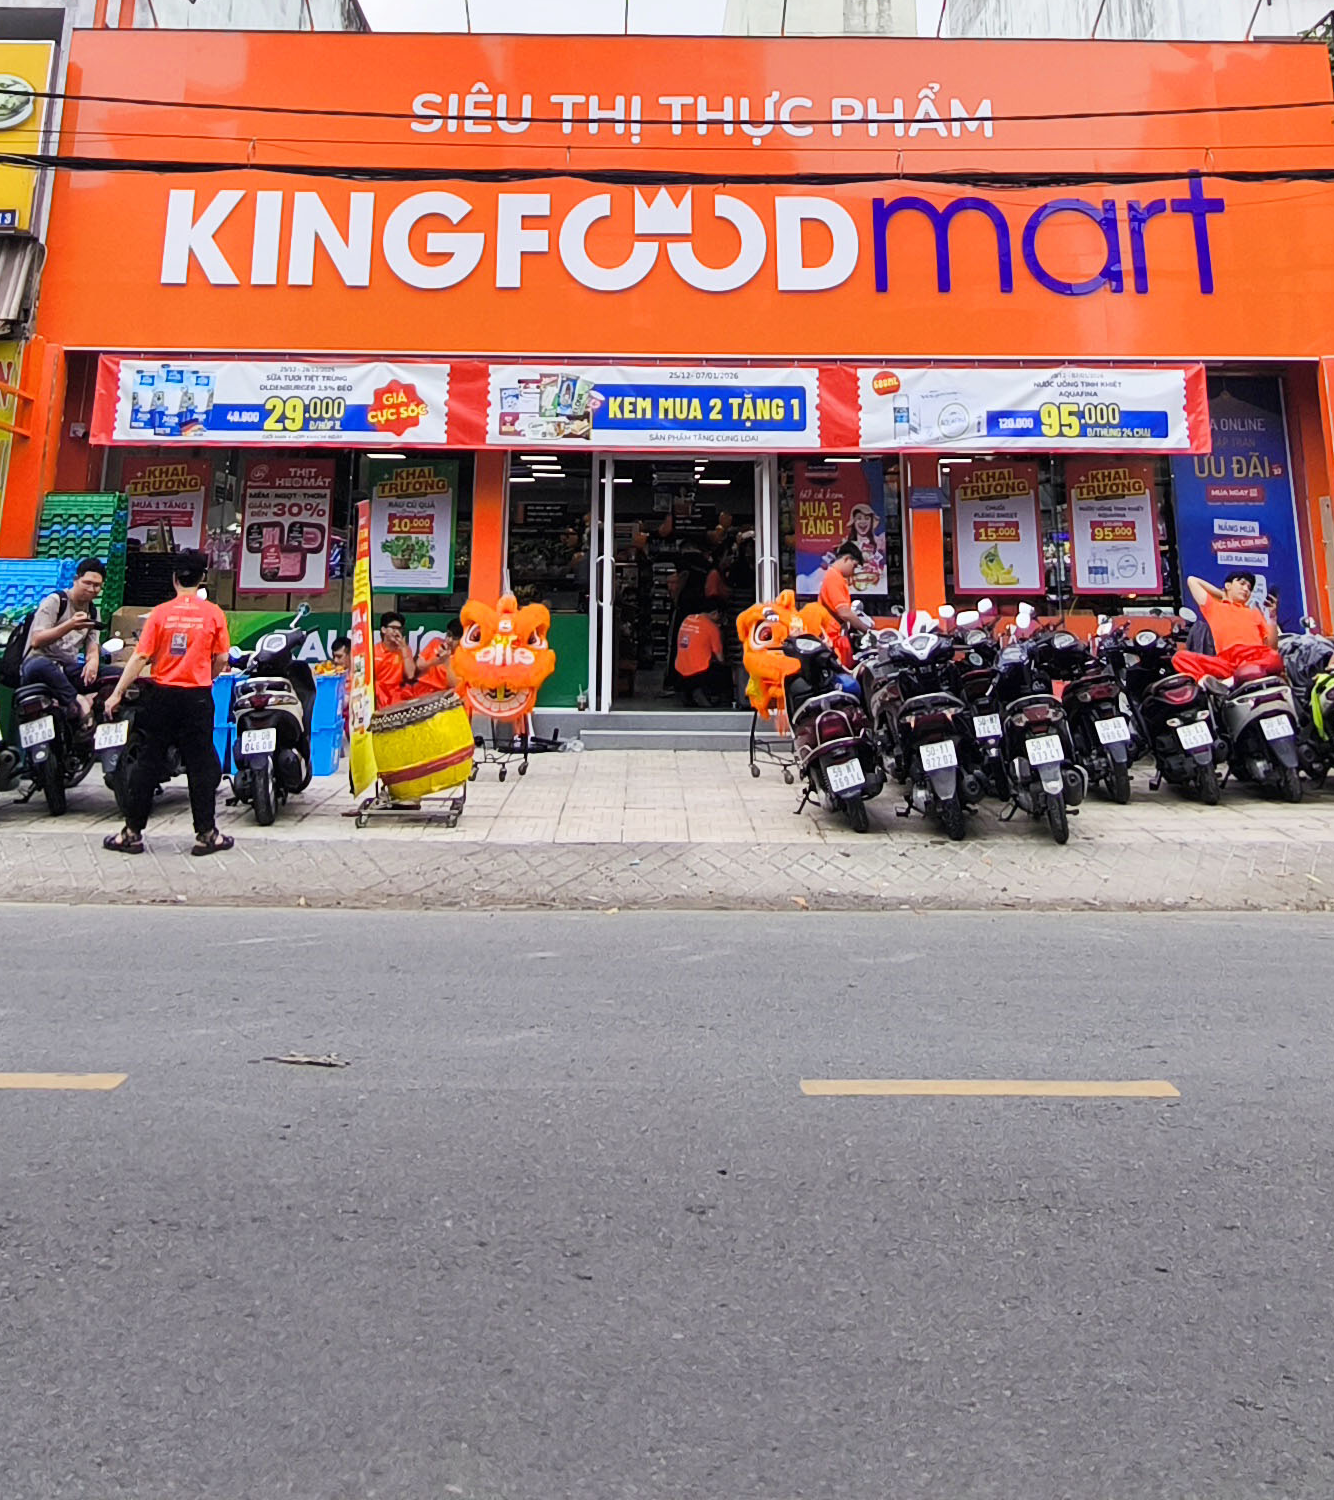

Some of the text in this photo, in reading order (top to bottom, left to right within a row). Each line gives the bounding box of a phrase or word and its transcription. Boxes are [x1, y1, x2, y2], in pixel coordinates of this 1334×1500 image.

[411, 82, 995, 147] SIÊU THỊ THỰC PHẨM
[382, 389, 408, 405] GIÁ
[367, 401, 429, 425] CỰC SỐC
[608, 393, 800, 428] KEM MUA 2 TẶNG 1
[1220, 418, 1266, 432] ONLINE
[147, 466, 187, 480] KHAI
[394, 467, 433, 481] KHAI
[973, 469, 1013, 484] KHAI
[1089, 469, 1128, 484] KHAI
[272, 502, 327, 518] 30%
[799, 501, 842, 517] MUA 2
[838, 520, 844, 536] 1
